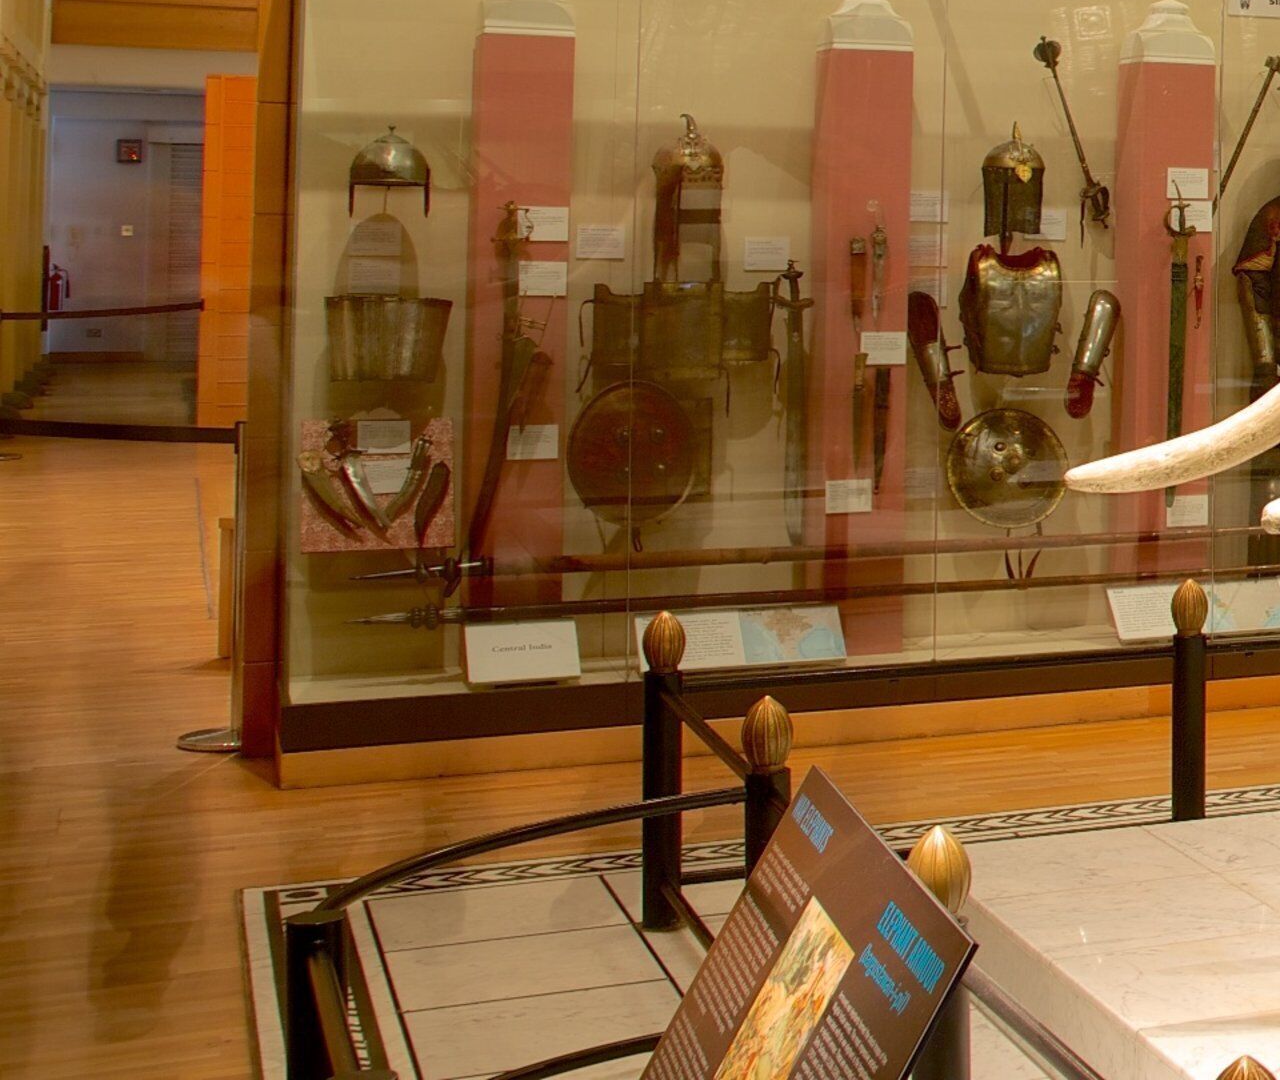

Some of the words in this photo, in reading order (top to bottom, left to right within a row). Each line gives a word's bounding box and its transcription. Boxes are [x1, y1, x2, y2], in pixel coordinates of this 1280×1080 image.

[491, 644, 526, 653] Central
[876, 900, 920, 961] ELEPHANT
[905, 936, 945, 994] ARMOUR
